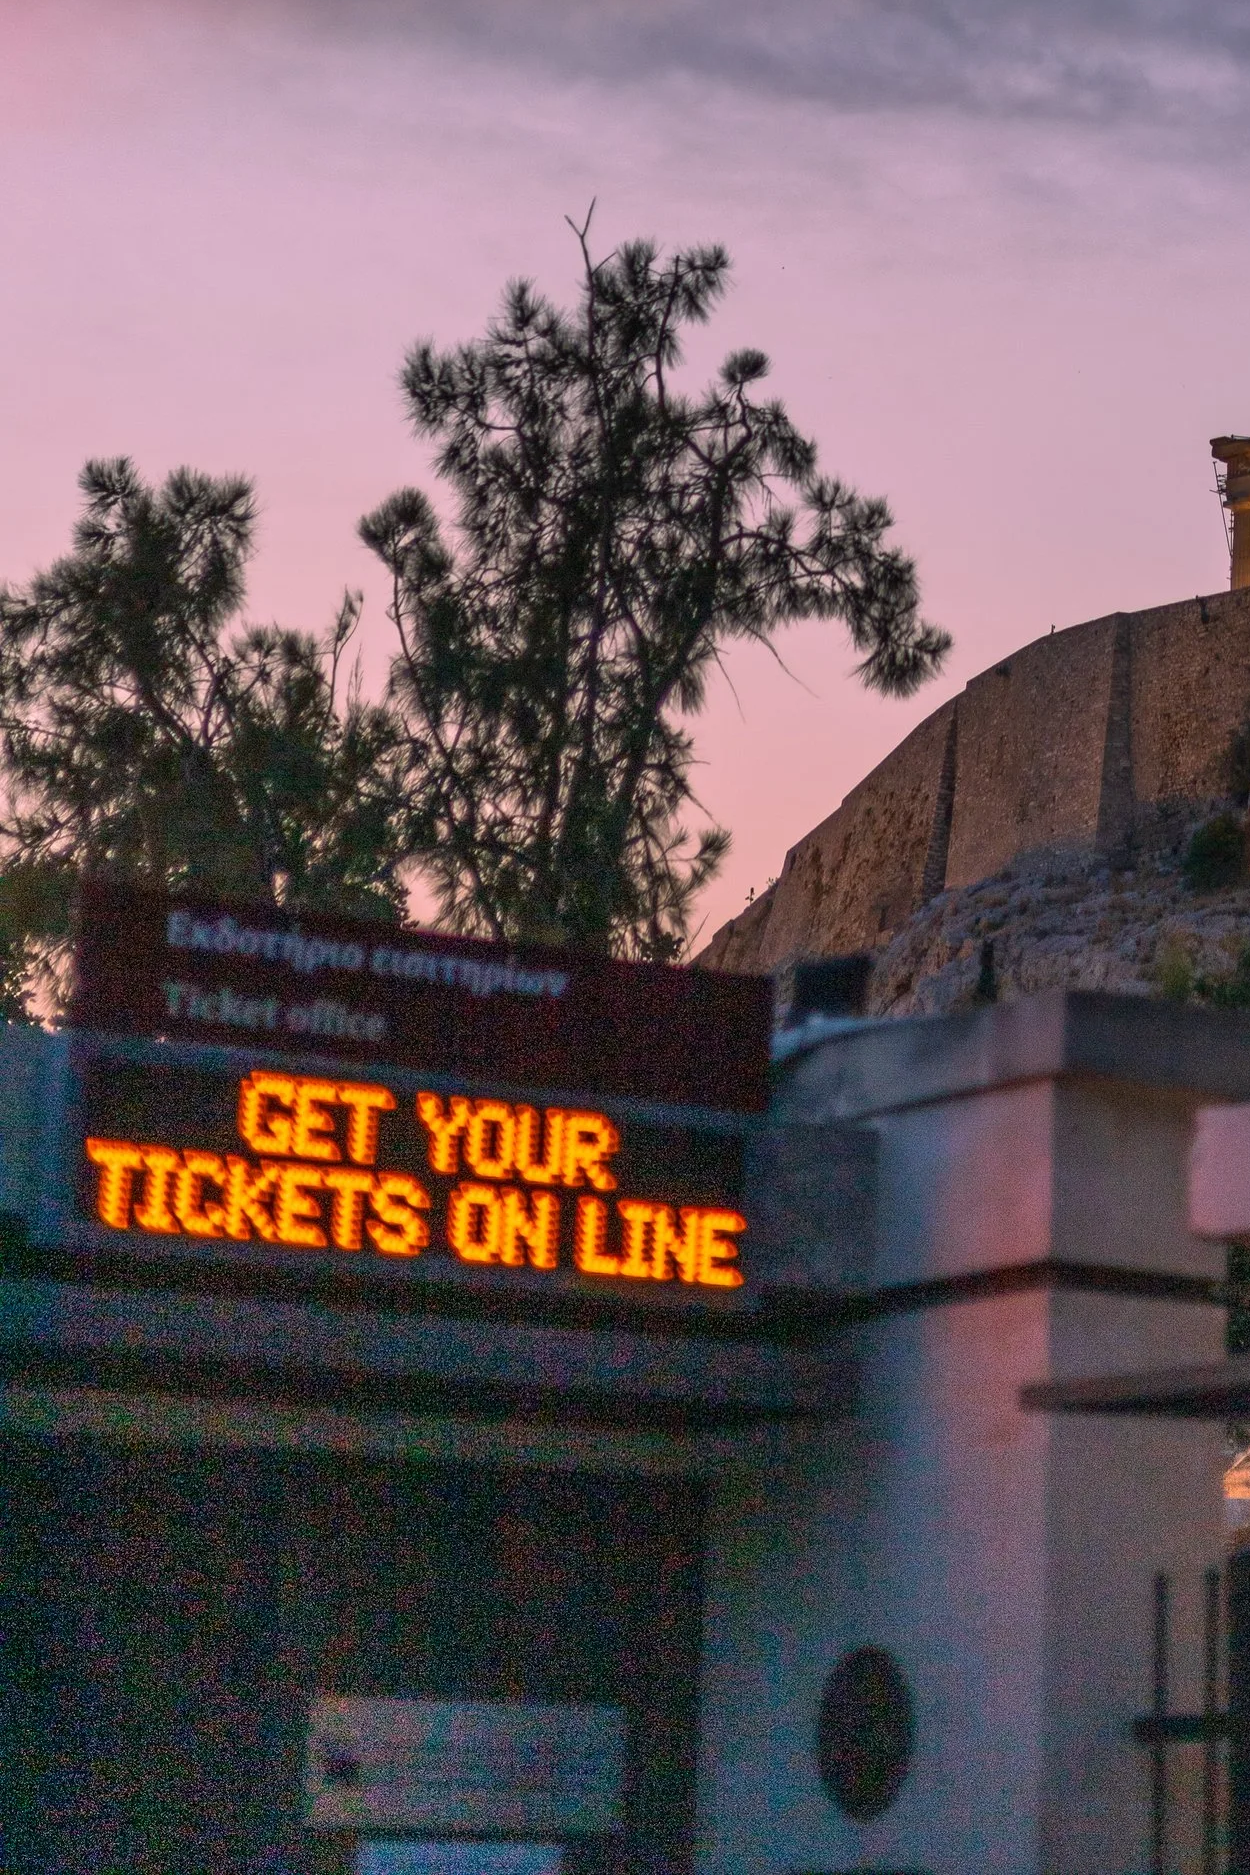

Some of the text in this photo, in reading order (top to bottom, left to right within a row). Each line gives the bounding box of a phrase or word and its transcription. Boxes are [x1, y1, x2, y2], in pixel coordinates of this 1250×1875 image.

[162, 980, 387, 1041] Ticket office
[238, 1070, 619, 1190] GET YOUR
[86, 1137, 747, 1288] TICKETS ON LINE
